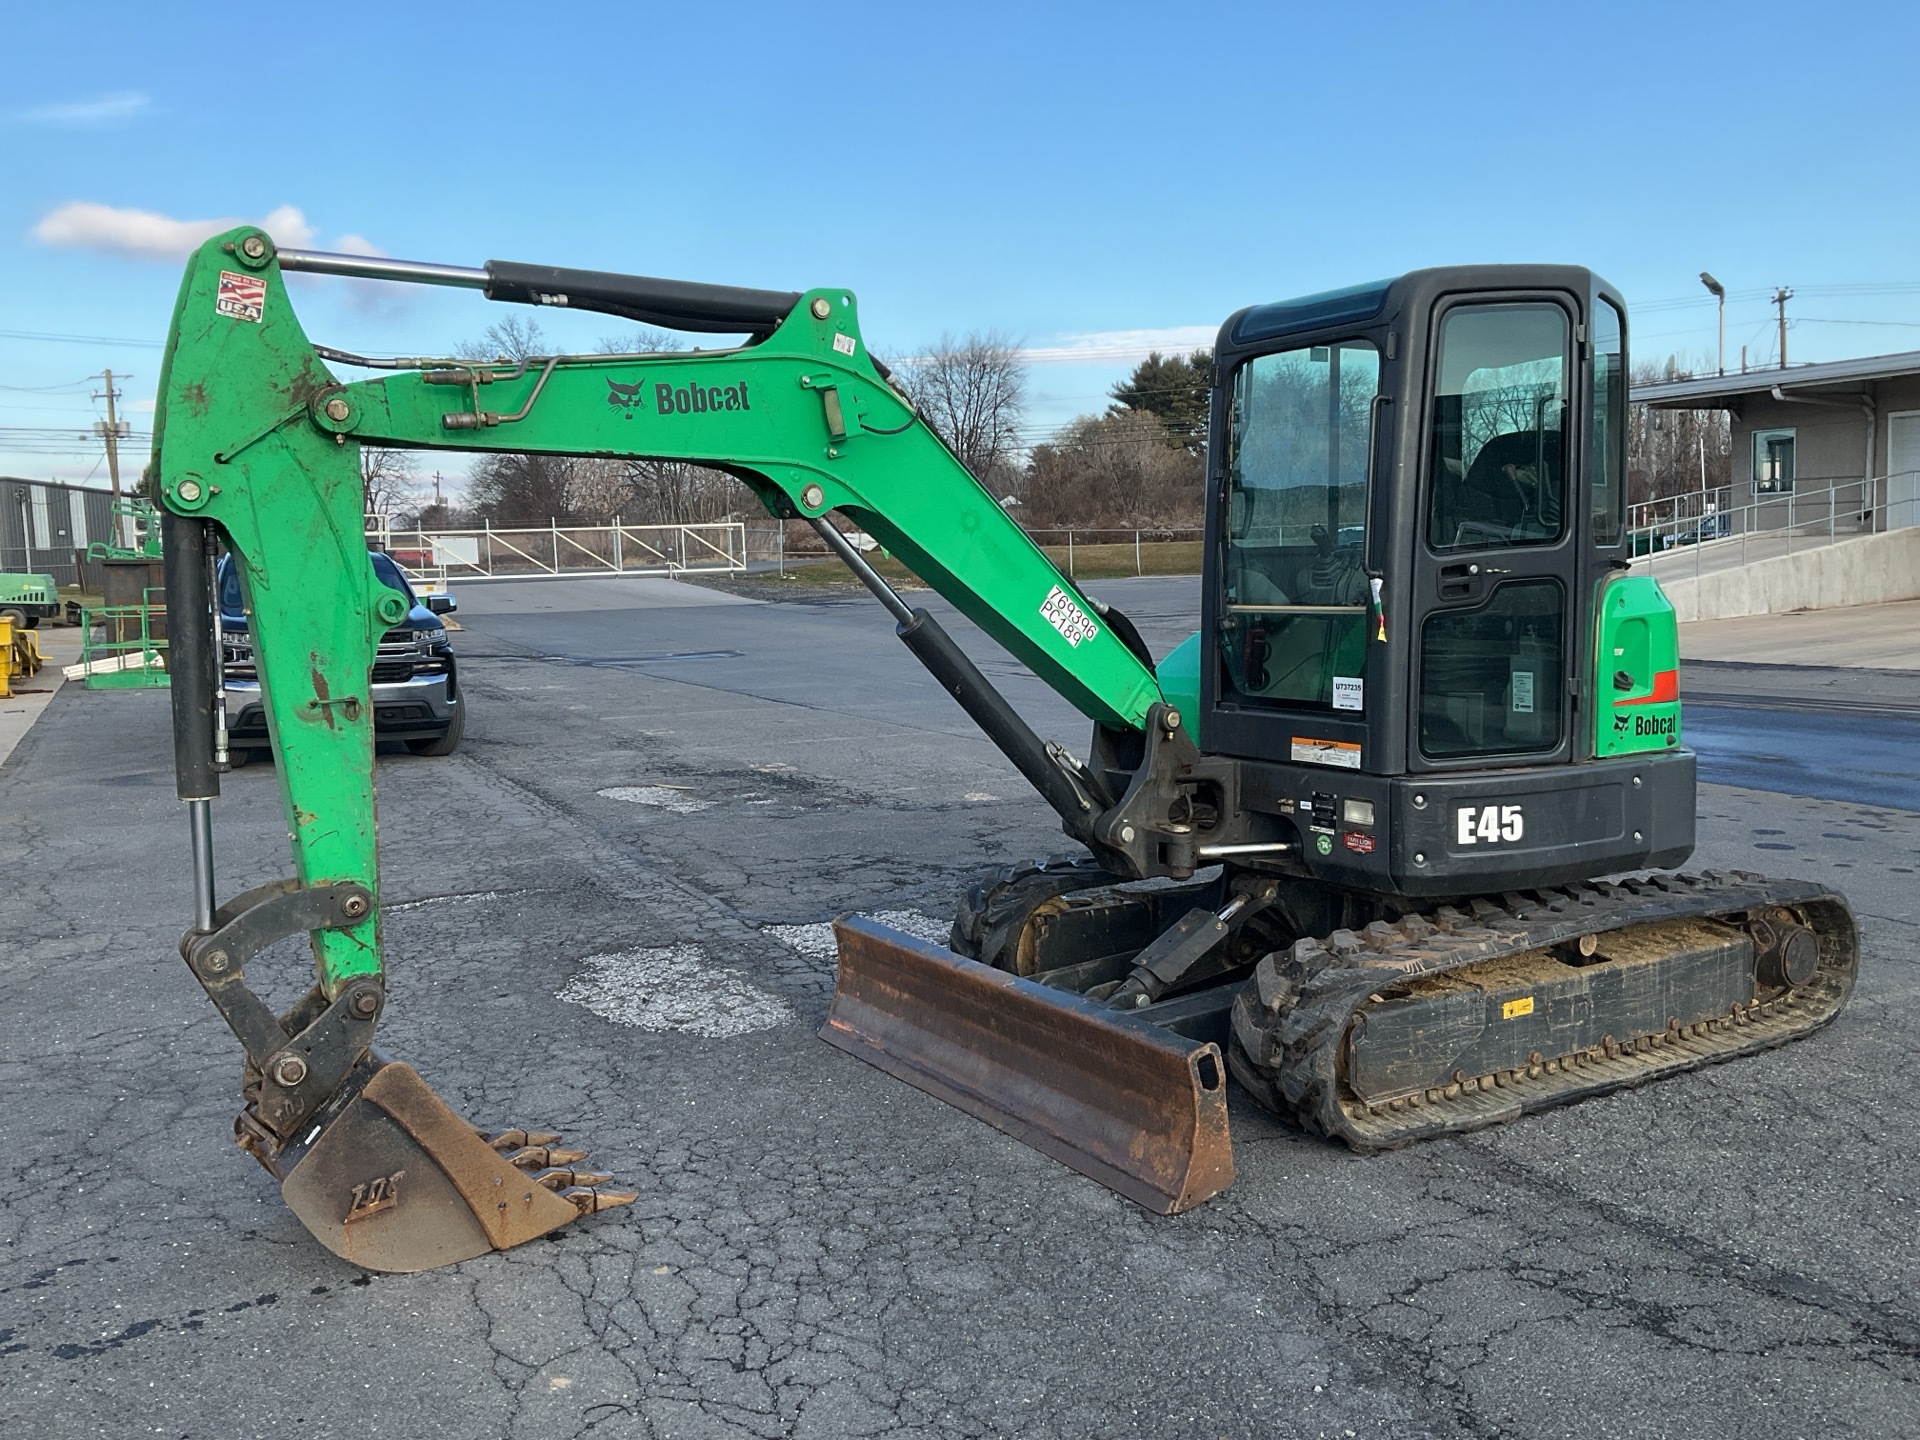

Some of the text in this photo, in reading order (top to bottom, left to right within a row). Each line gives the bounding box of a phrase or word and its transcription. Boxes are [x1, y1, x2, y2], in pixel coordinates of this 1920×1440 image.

[219, 299, 259, 318] USA
[655, 381, 750, 415] Bobcat
[1040, 600, 1081, 647] PC189
[1050, 586, 1097, 639] 769396
[1457, 805, 1523, 844] E45
